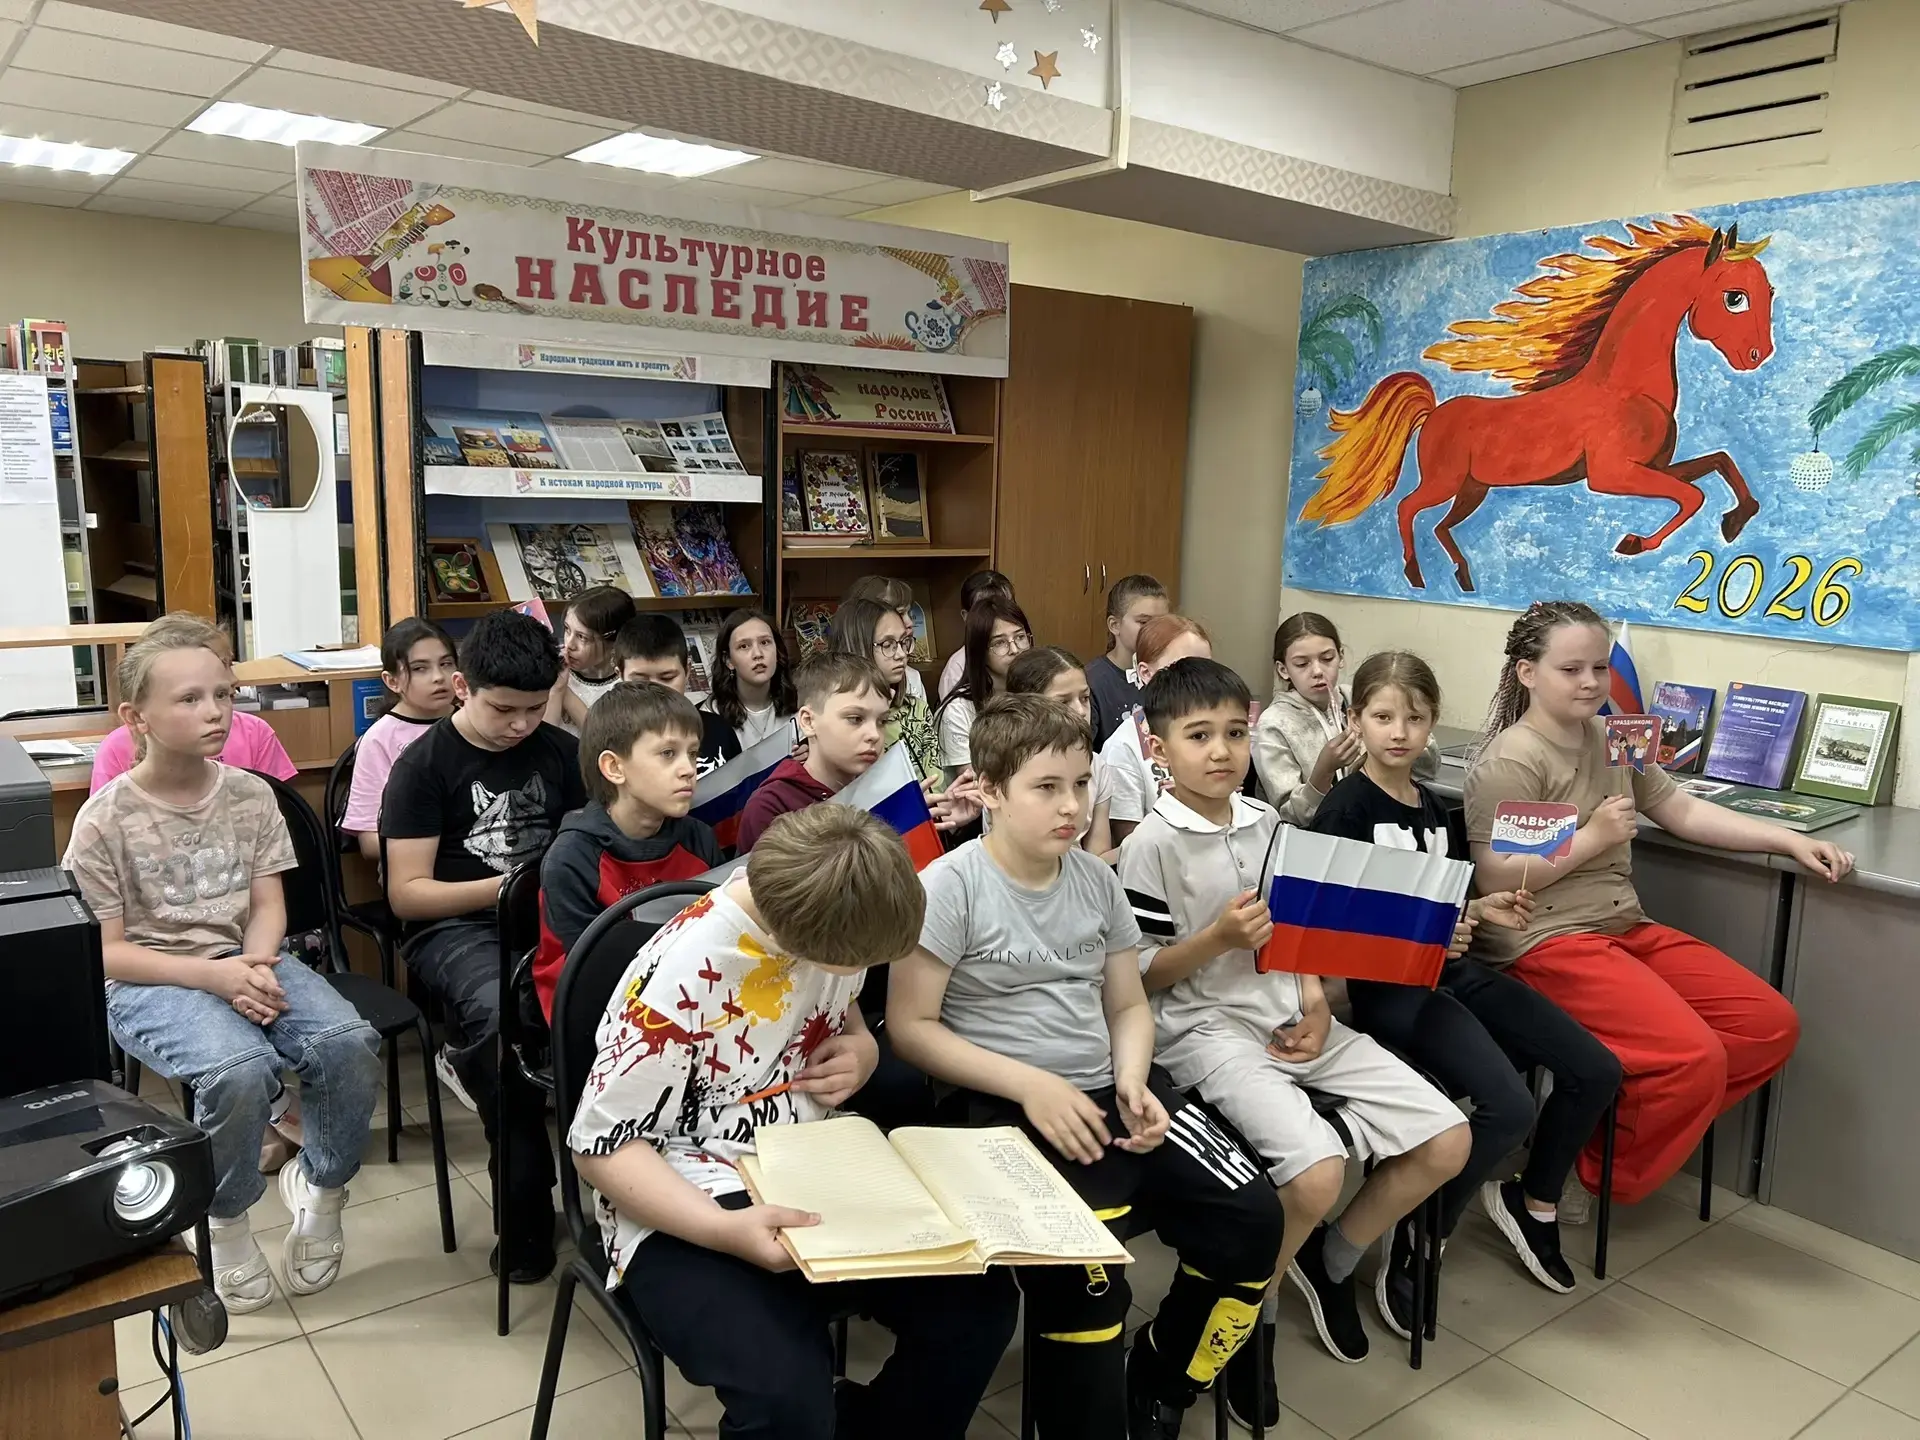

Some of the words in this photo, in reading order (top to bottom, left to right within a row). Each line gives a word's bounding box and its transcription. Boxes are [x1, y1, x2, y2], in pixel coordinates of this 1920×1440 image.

[566, 216, 826, 281] Культурное
[515, 256, 868, 332] НАСЛЕДИЕ
[540, 353, 576, 364] Народным
[616, 360, 633, 369] жить
[540, 477, 546, 486] К
[548, 478, 583, 487] истокам
[585, 479, 624, 489] народной
[625, 480, 663, 491] культуры
[1674, 550, 1863, 627] 2026
[1828, 718, 1875, 728] TATARICA
[1500, 814, 1569, 831] СЛАВЬСЯ,
[1498, 827, 1559, 841] РОССИЯ!
